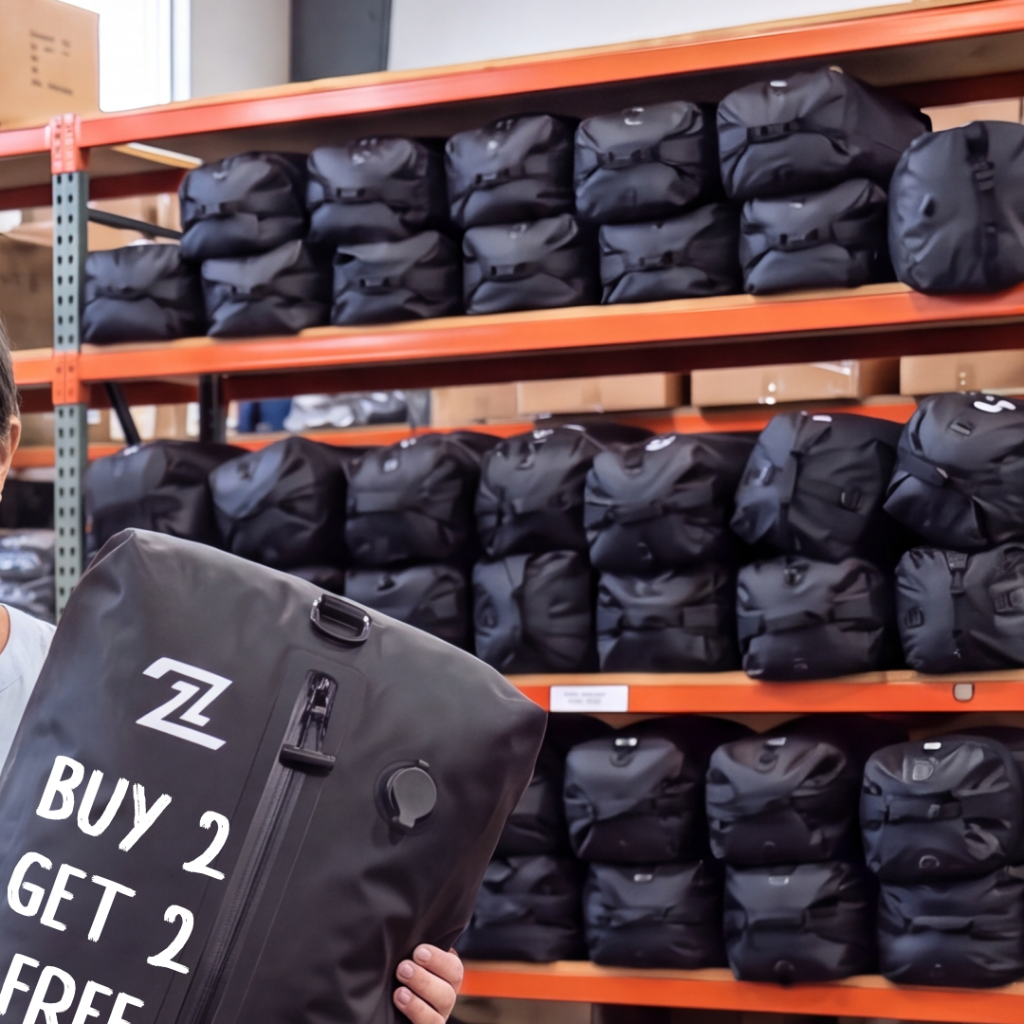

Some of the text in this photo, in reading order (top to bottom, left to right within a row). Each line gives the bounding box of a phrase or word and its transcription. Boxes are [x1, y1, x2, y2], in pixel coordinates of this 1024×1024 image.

[36, 755, 229, 880] BUY 2
[7, 852, 194, 974] GET 2
